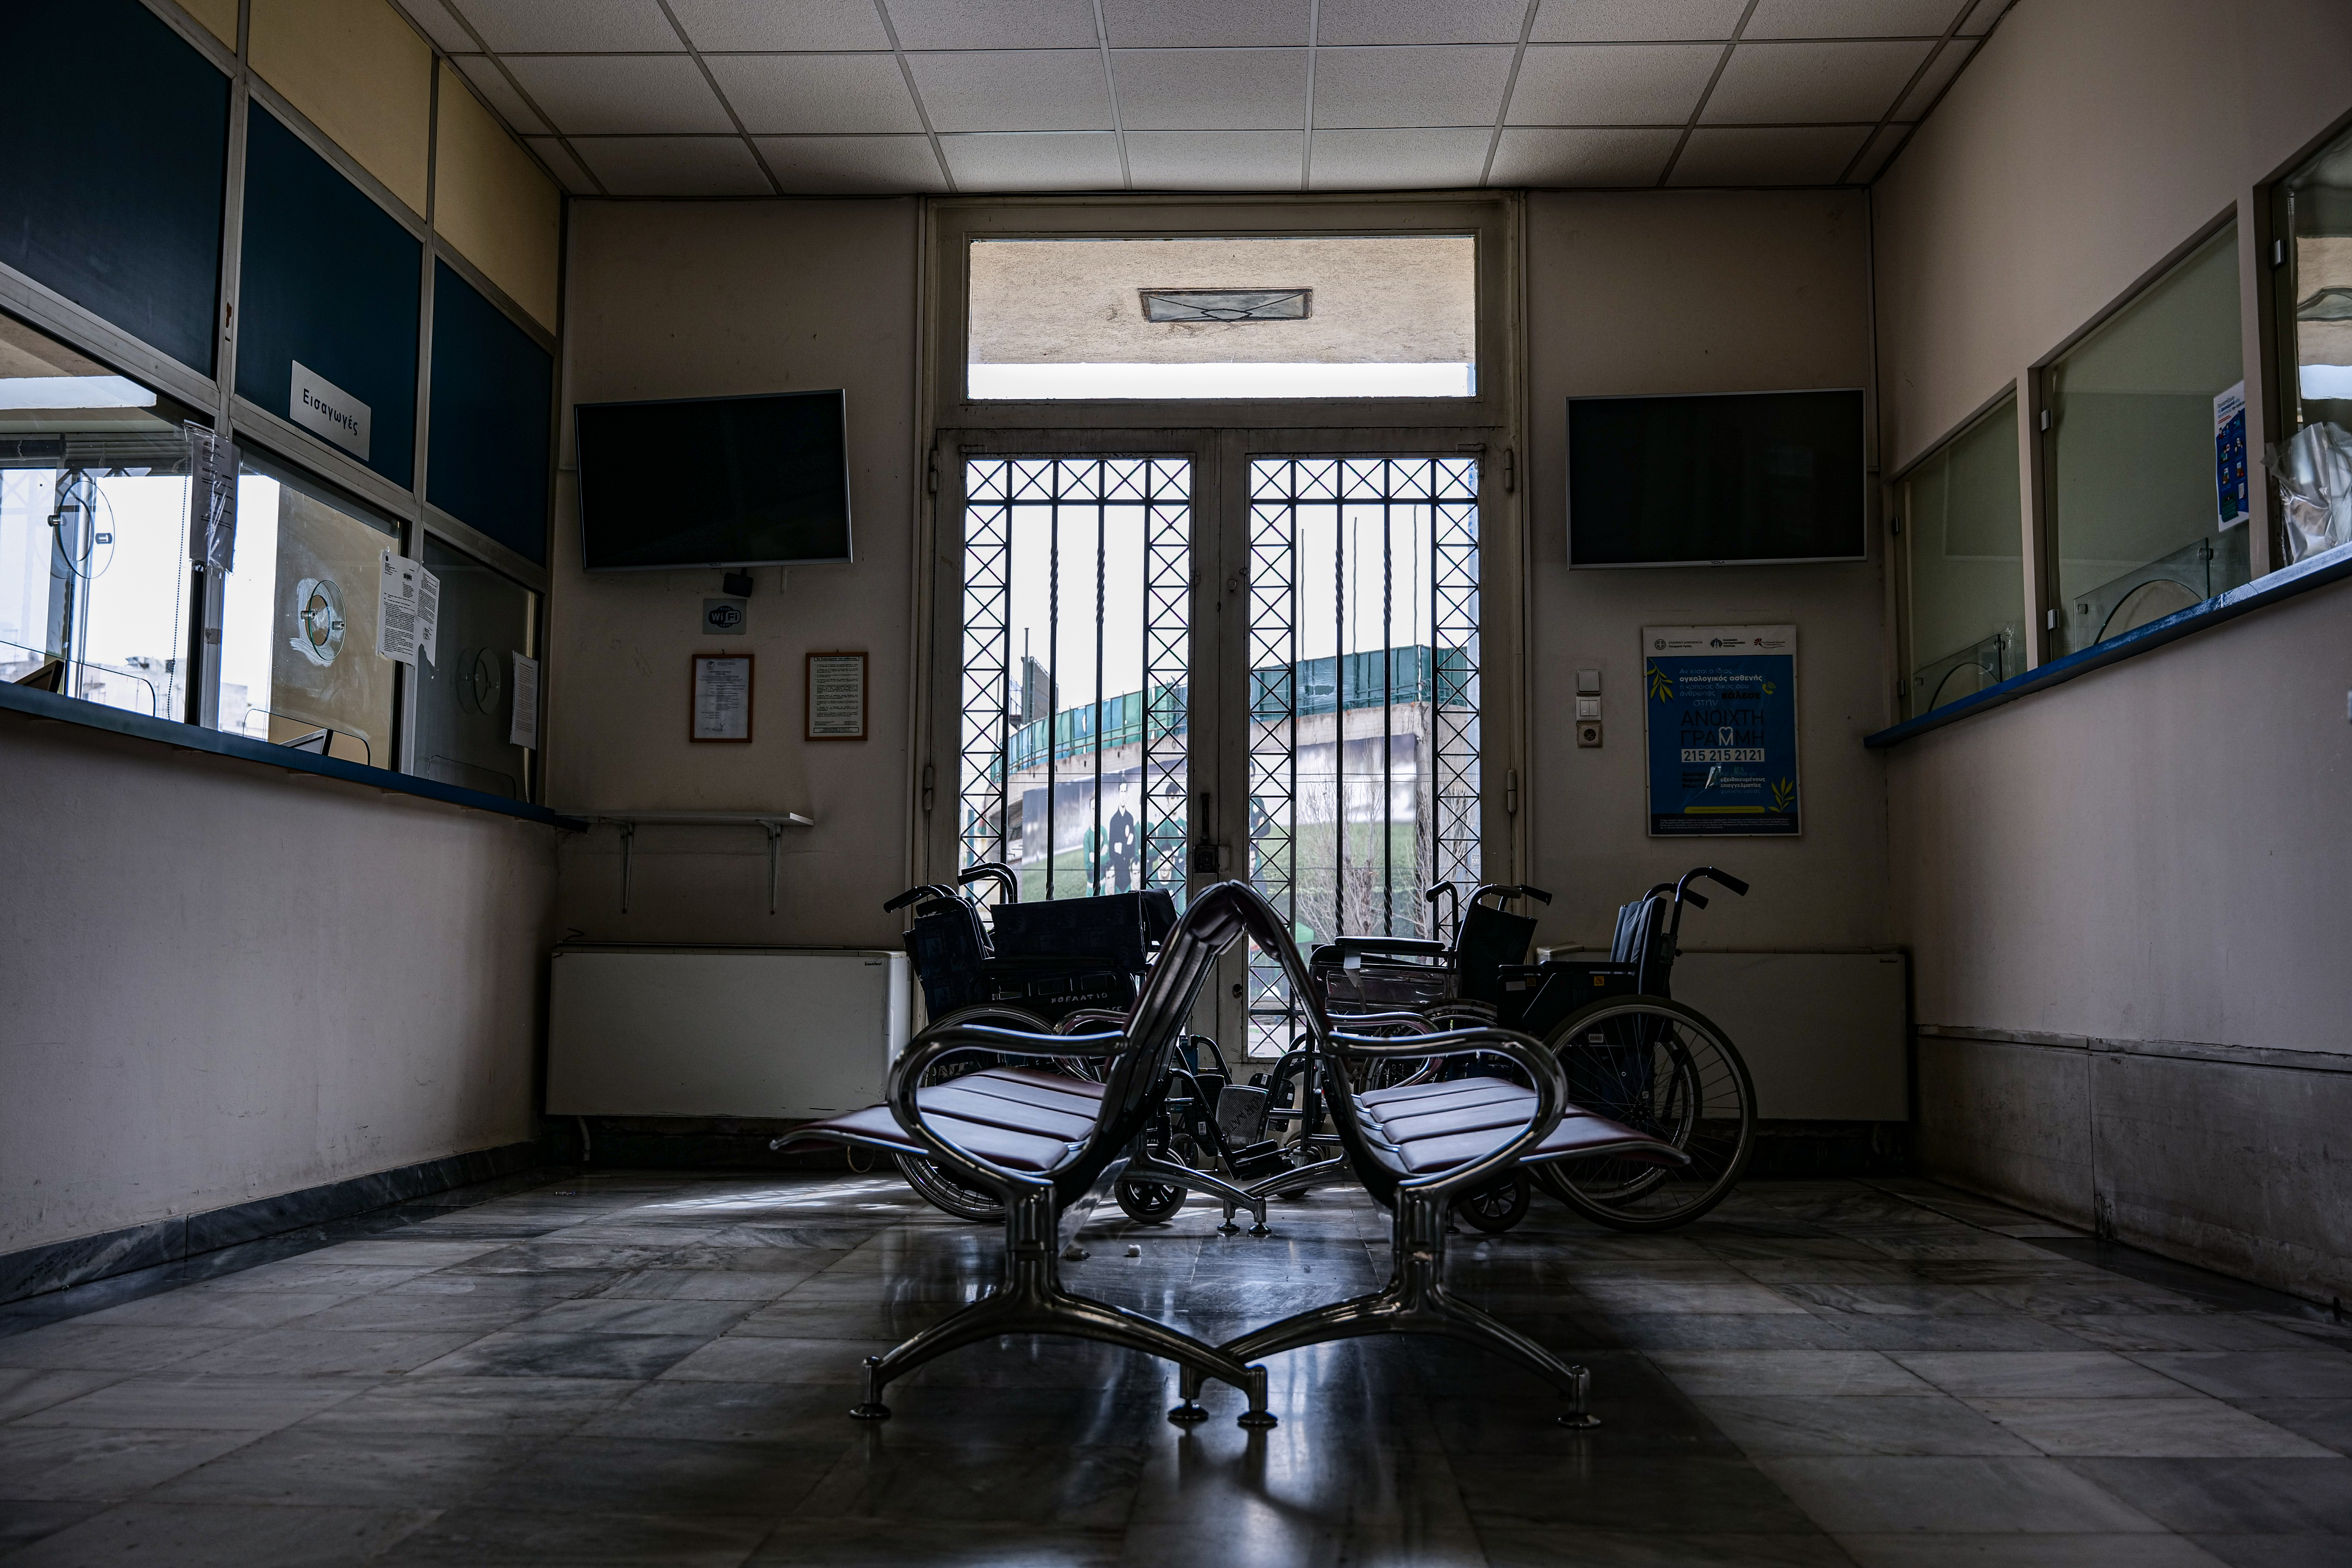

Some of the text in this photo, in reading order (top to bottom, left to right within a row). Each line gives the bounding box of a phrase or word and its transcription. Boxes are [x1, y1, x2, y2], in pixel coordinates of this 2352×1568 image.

[303, 388, 358, 436] Εισαγωγές
[1721, 691, 1761, 700] κάλεσε
[1681, 710, 1764, 726] ΑΝΟΙΧΤΗ
[1681, 726, 1764, 746] ΓΡΑΜΜΗ
[1684, 750, 1761, 761] 215 215 2121
